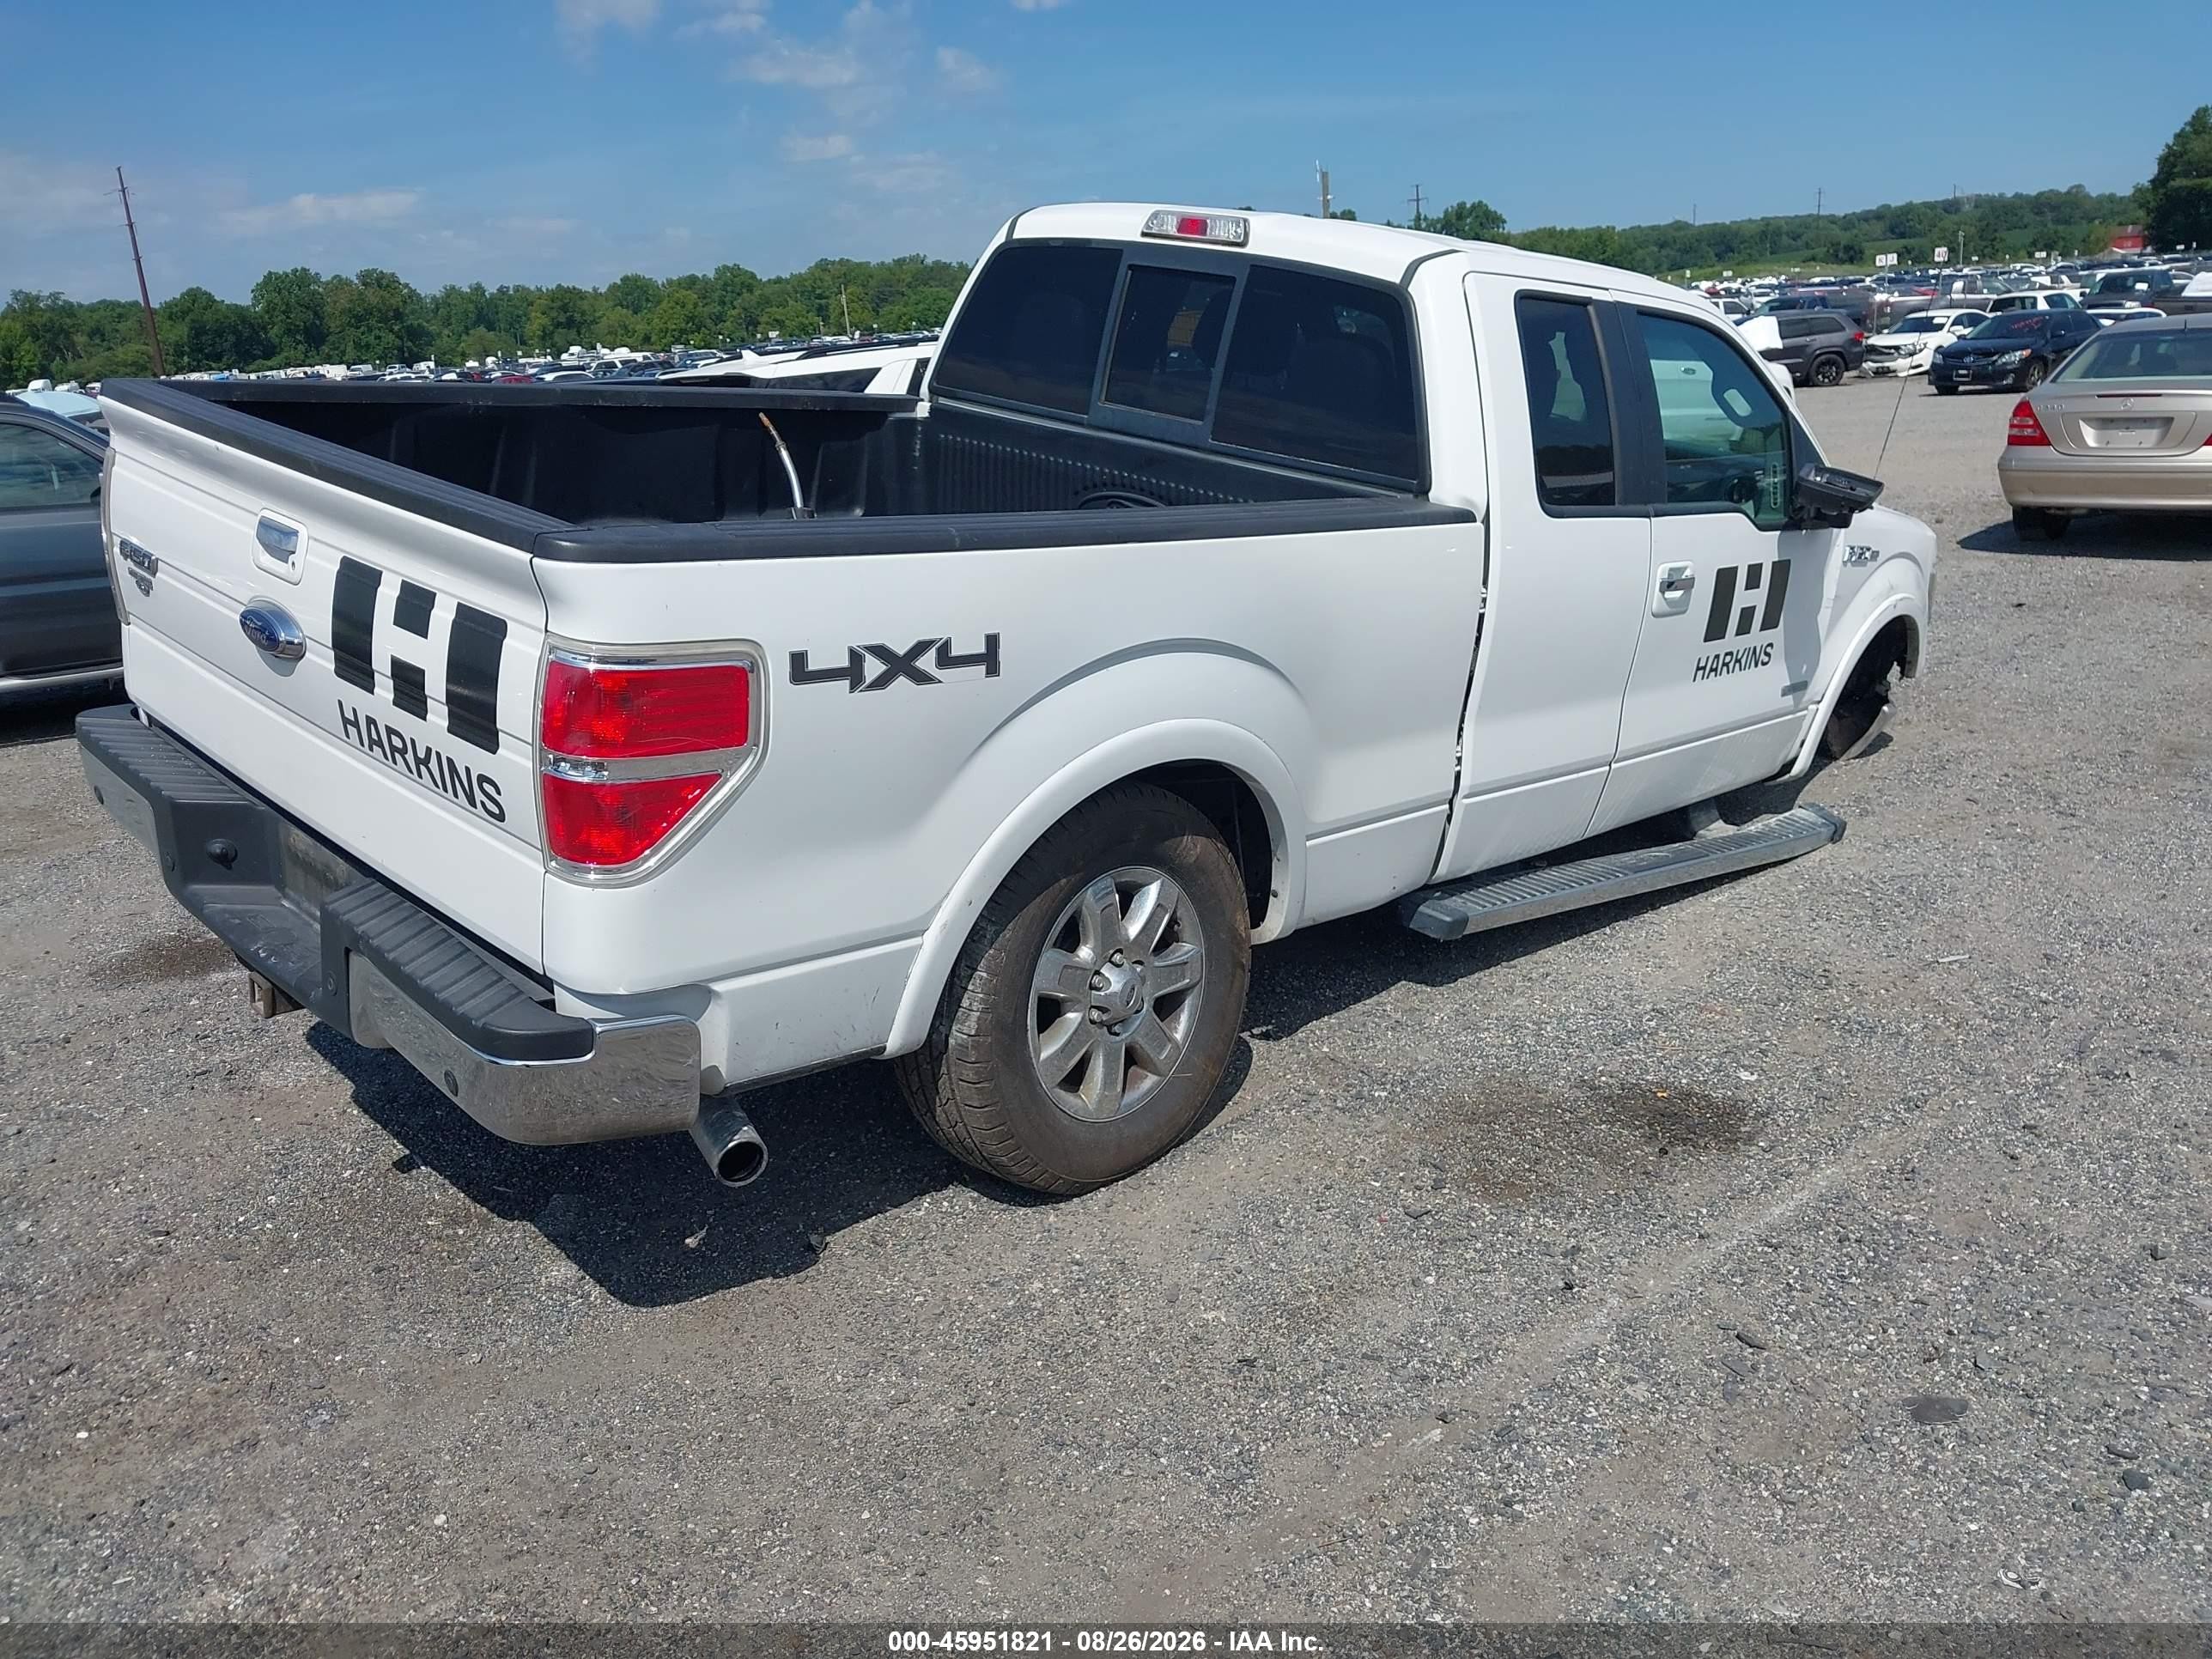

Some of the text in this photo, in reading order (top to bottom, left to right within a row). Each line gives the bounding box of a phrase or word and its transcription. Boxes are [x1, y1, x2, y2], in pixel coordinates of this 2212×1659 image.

[241, 615, 272, 646] Ford
[1692, 642, 1774, 683] HARKINS
[337, 699, 506, 823] HARKINS
